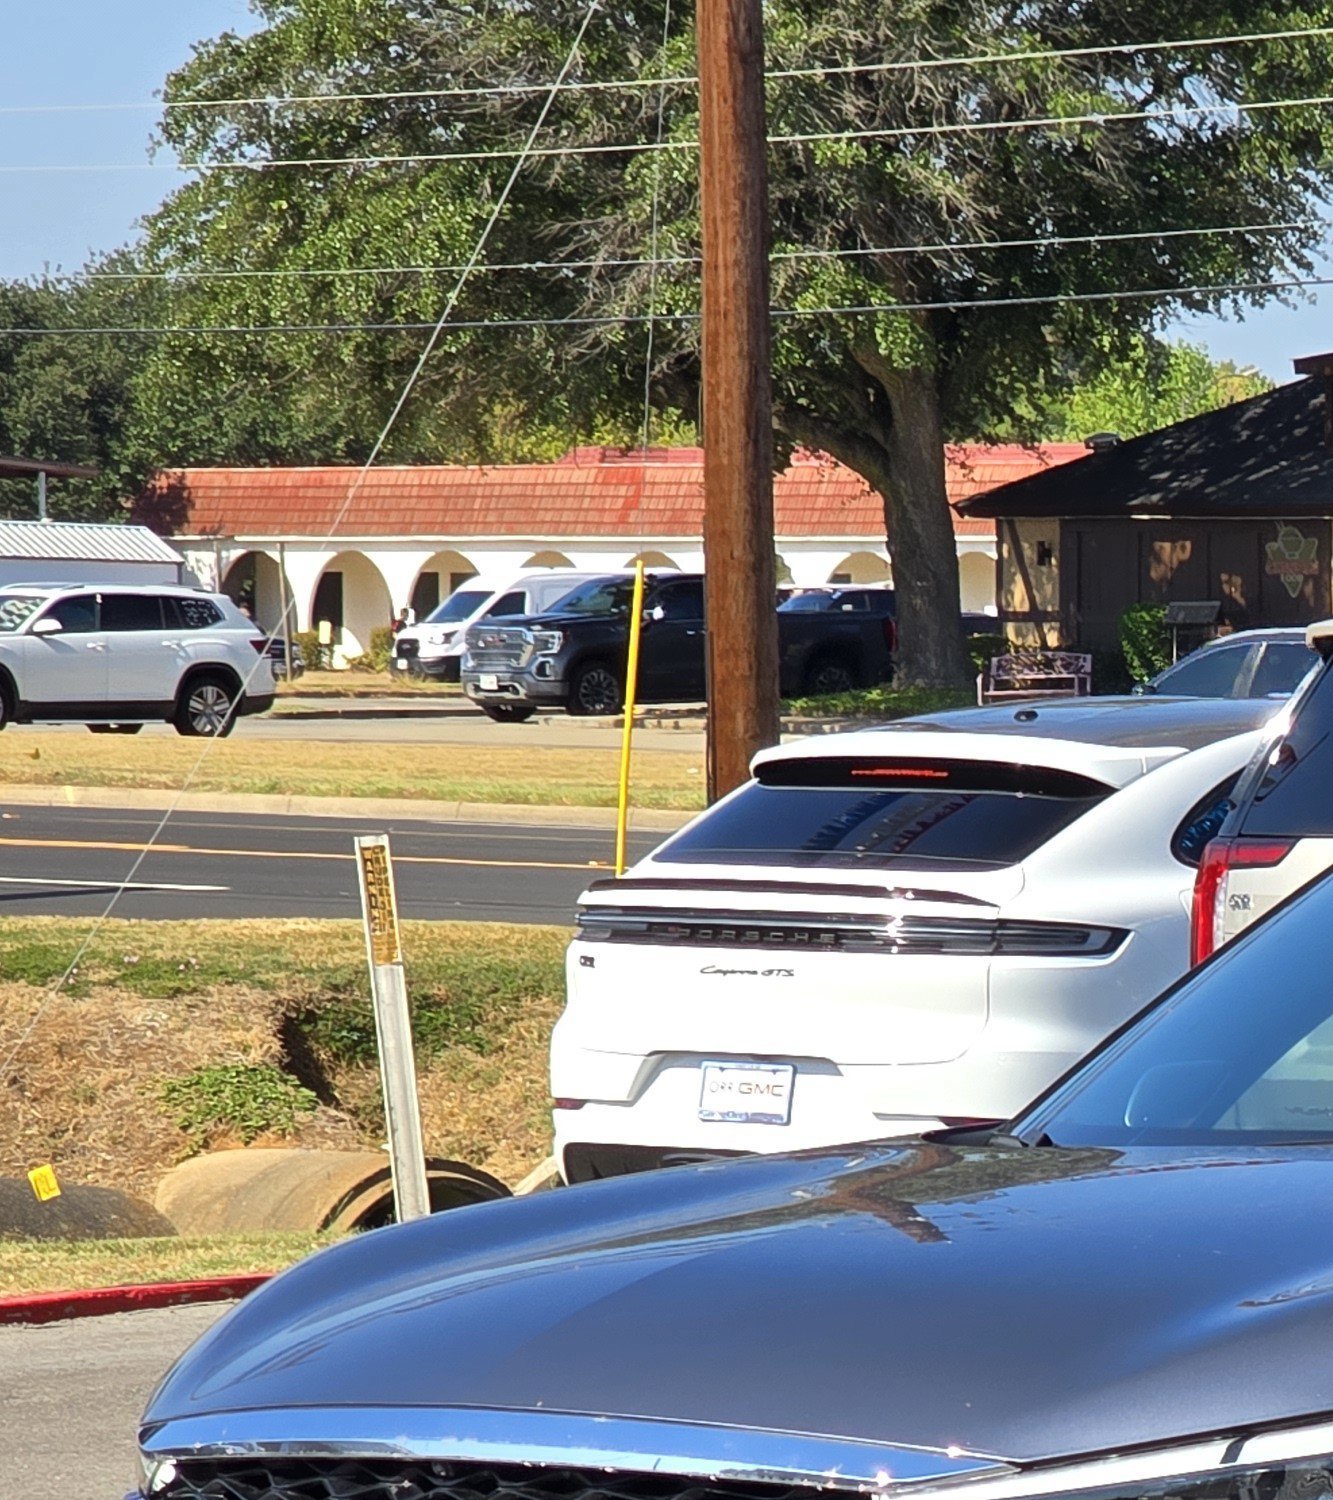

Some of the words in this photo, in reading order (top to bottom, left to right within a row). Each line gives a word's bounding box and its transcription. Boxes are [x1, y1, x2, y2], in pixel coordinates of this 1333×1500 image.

[677, 927, 836, 945] PORSCHE
[700, 965, 759, 977] Cayenne
[761, 968, 796, 978] GTS
[738, 1082, 785, 1097] GMC
